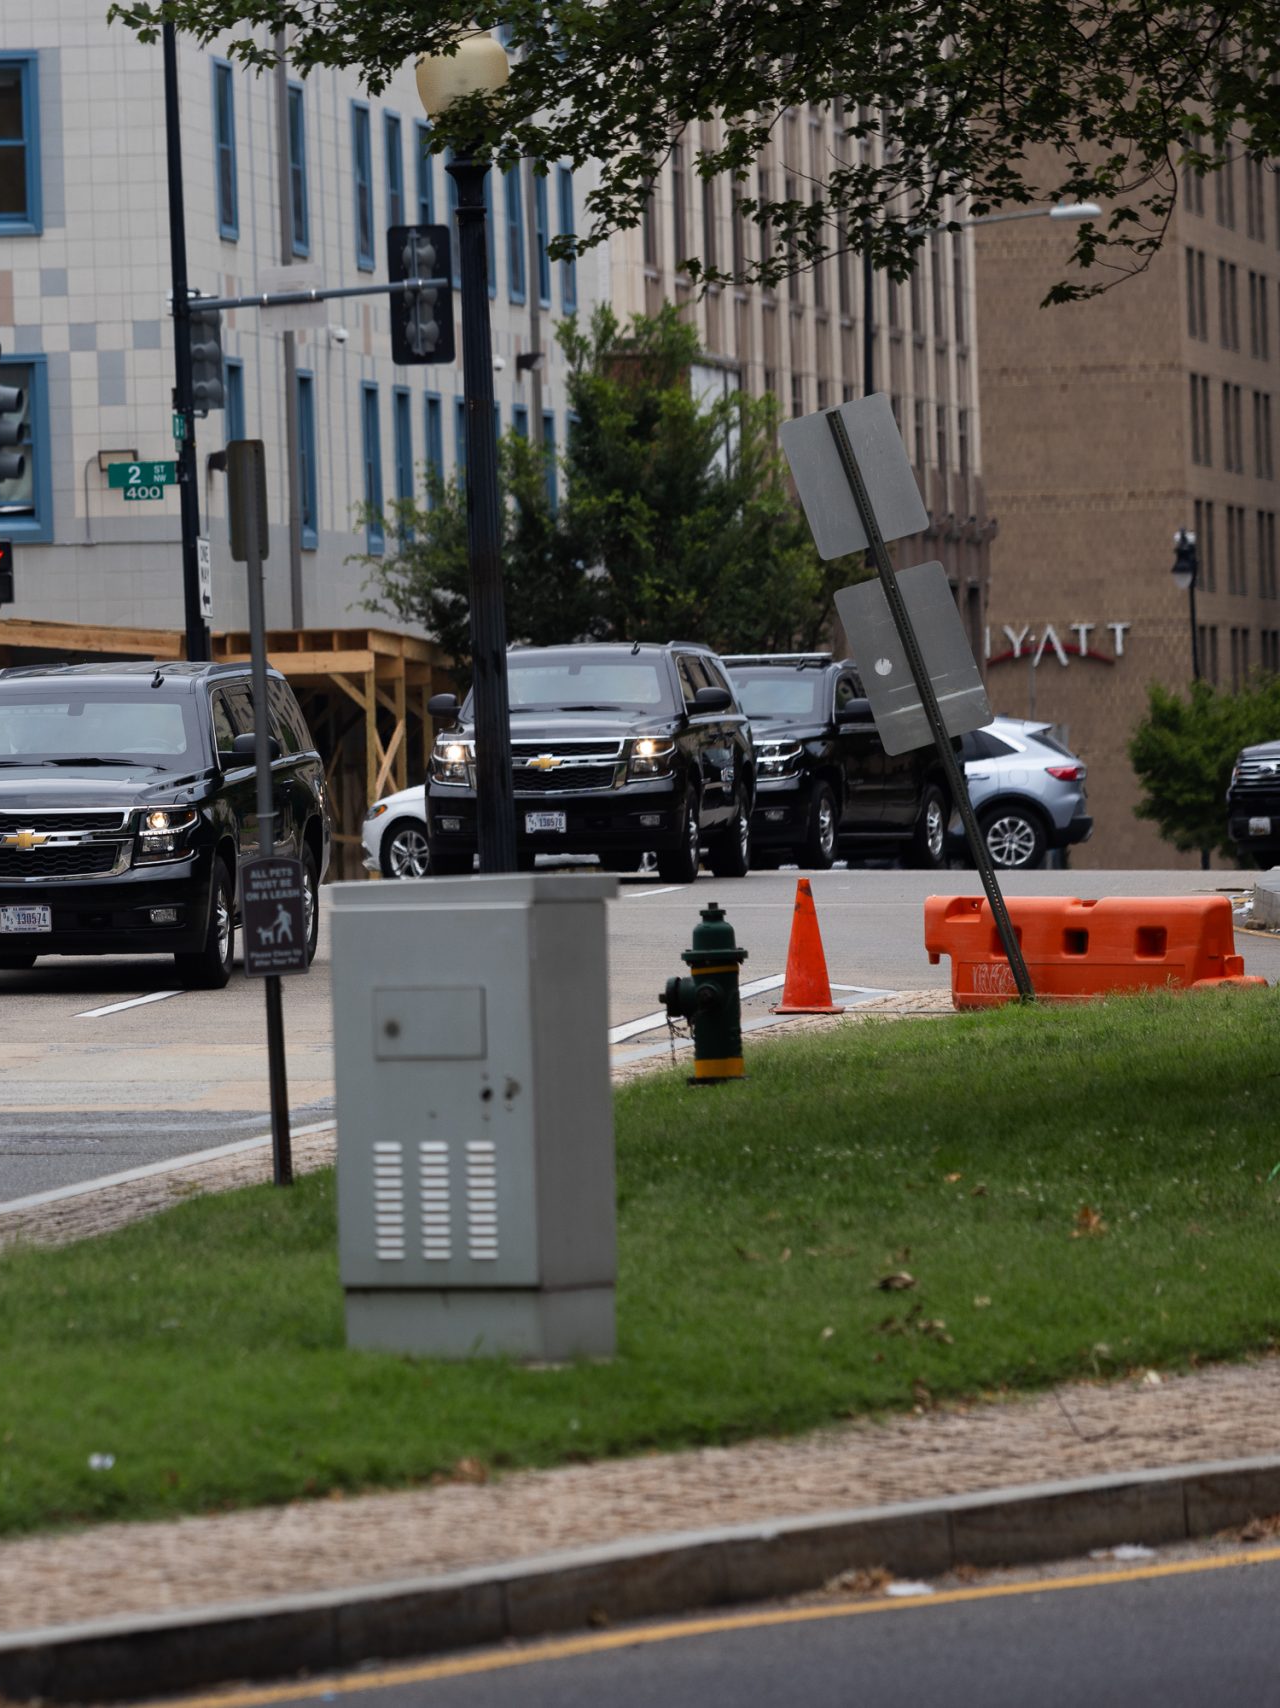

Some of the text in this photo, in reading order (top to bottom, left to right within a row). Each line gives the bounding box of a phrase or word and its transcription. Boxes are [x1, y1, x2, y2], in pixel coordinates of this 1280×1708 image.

[128, 465, 165, 484] 2 ST
[153, 474, 166, 483] NW
[126, 486, 161, 499] 400
[250, 867, 294, 879] ALL PETS
[251, 878, 292, 890] MUST BE
[261, 892, 269, 900] A
[270, 889, 300, 900] LEASH
[16, 912, 47, 925] 130574
